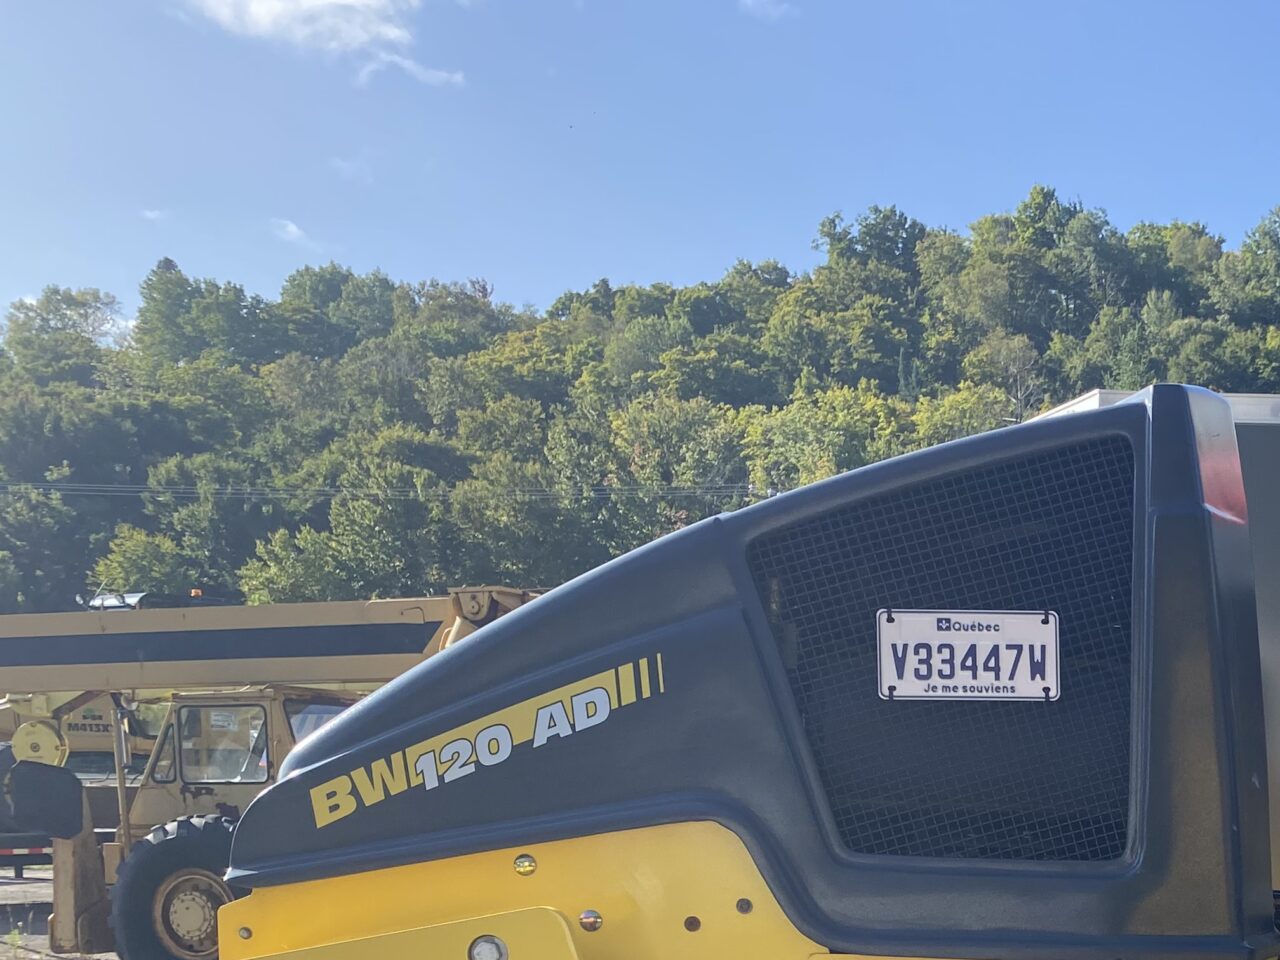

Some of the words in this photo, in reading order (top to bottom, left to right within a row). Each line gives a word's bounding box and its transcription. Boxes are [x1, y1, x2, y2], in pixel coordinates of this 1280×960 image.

[953, 621, 1000, 633] Québec
[891, 642, 1047, 682] V33447W
[924, 683, 938, 693] Je
[942, 685, 959, 693] me
[962, 682, 1016, 694] souviens
[533, 686, 612, 749] AD
